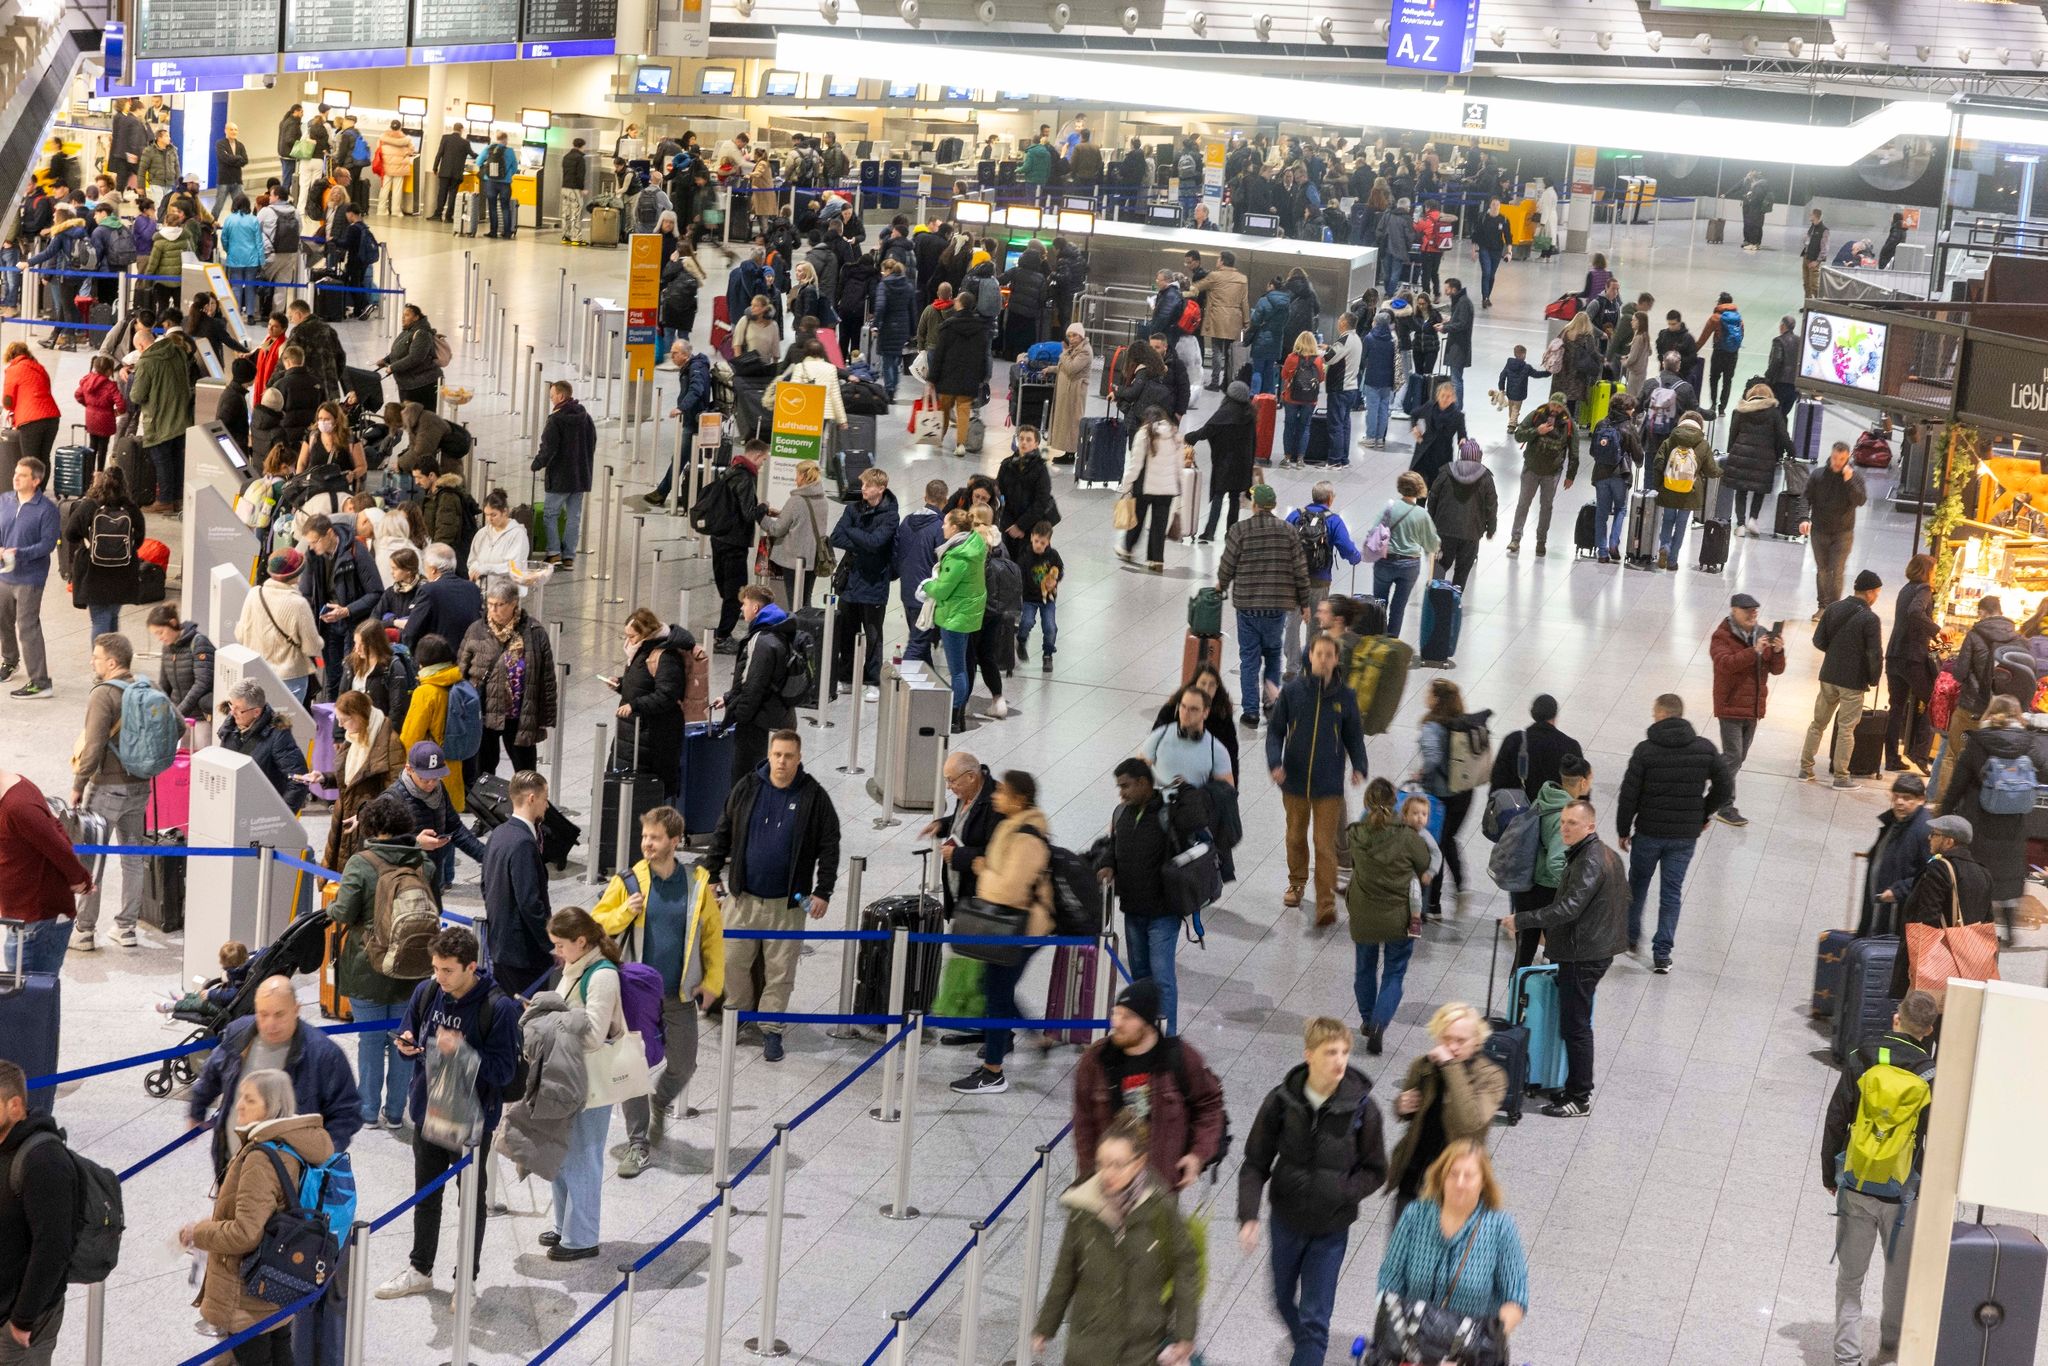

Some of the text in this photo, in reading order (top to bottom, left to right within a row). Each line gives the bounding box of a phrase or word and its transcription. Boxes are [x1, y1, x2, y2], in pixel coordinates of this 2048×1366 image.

[1396, 33, 1440, 63] A,Z
[629, 311, 643, 319] First
[629, 317, 645, 325] Class
[777, 420, 819, 432] Lufthansa
[775, 436, 814, 448] Economy
[774, 445, 798, 454] Class
[428, 754, 438, 769] B
